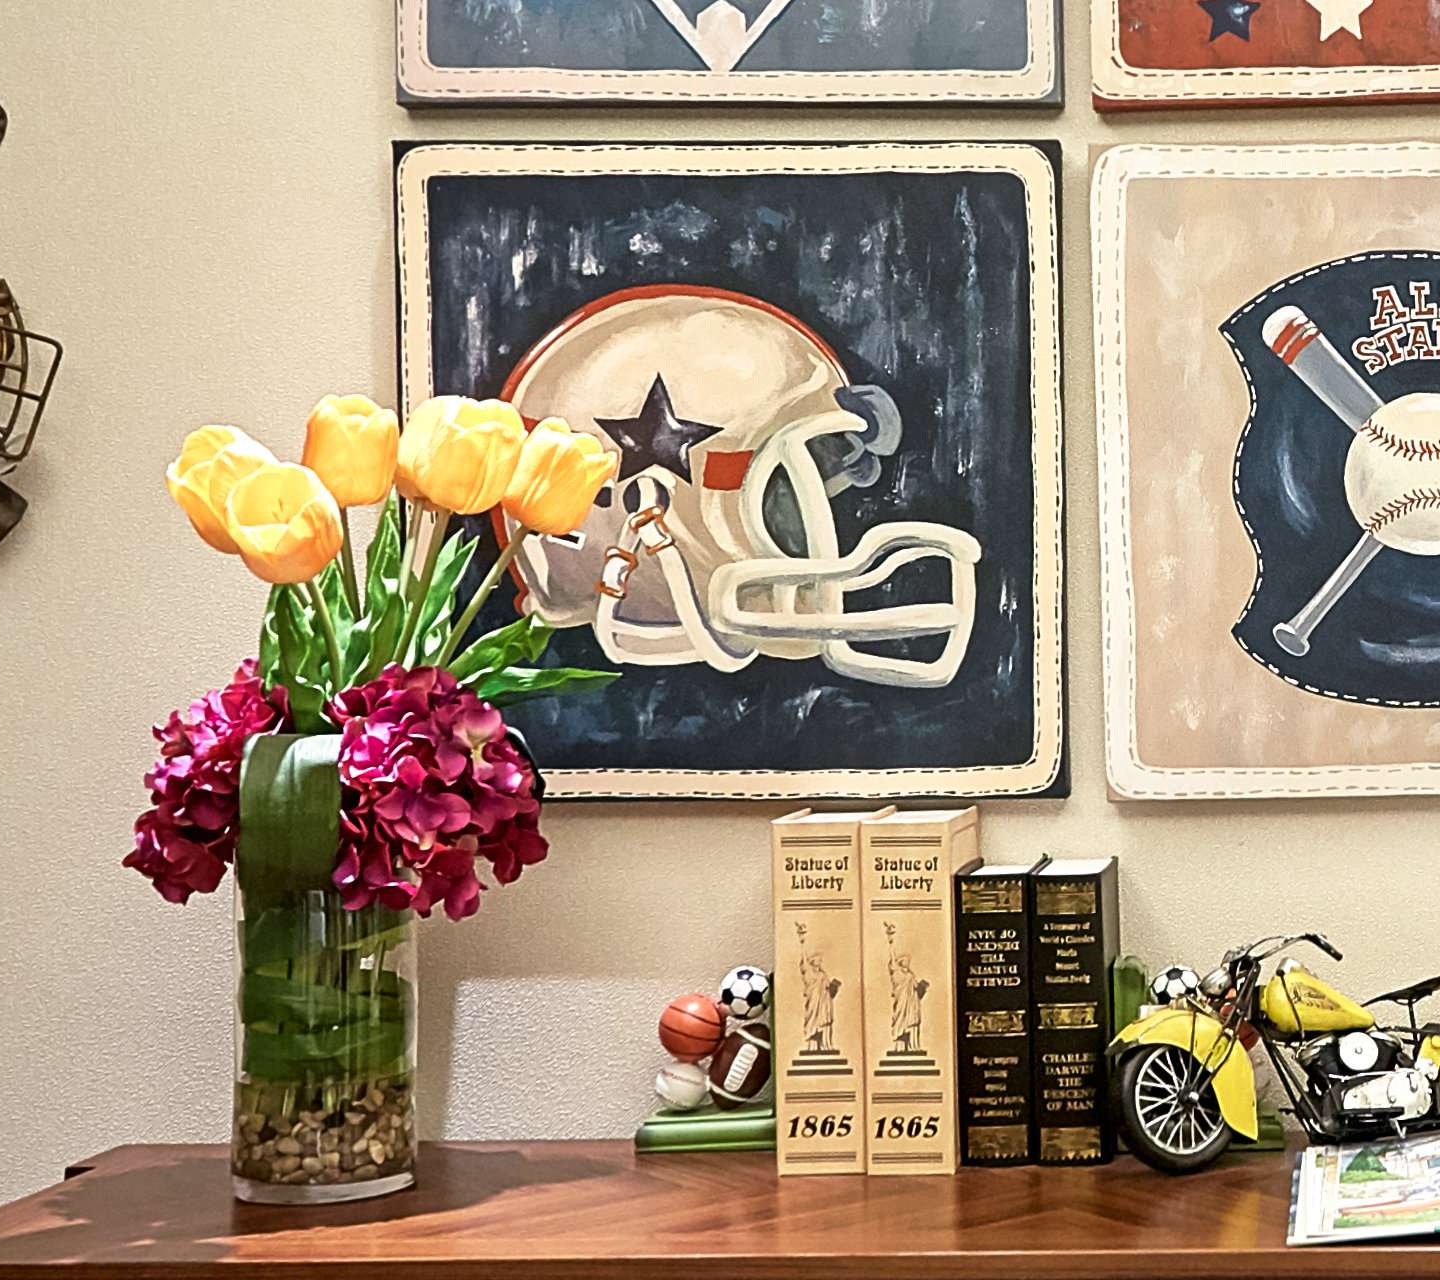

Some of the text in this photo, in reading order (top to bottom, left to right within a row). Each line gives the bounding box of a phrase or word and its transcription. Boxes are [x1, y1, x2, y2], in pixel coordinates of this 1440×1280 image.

[786, 856, 848, 871] Statue of
[875, 857, 938, 871] Statue of
[792, 875, 843, 891] Liberty
[881, 876, 933, 892] Liberty
[968, 929, 1016, 939] OF MAN
[966, 941, 1020, 952] DESCENT
[966, 977, 1021, 987] CHARLES
[1058, 1078, 1081, 1087] THE
[1046, 1100, 1094, 1111] OF MAN
[789, 1116, 853, 1137] 1865
[876, 1116, 939, 1138] 1865
